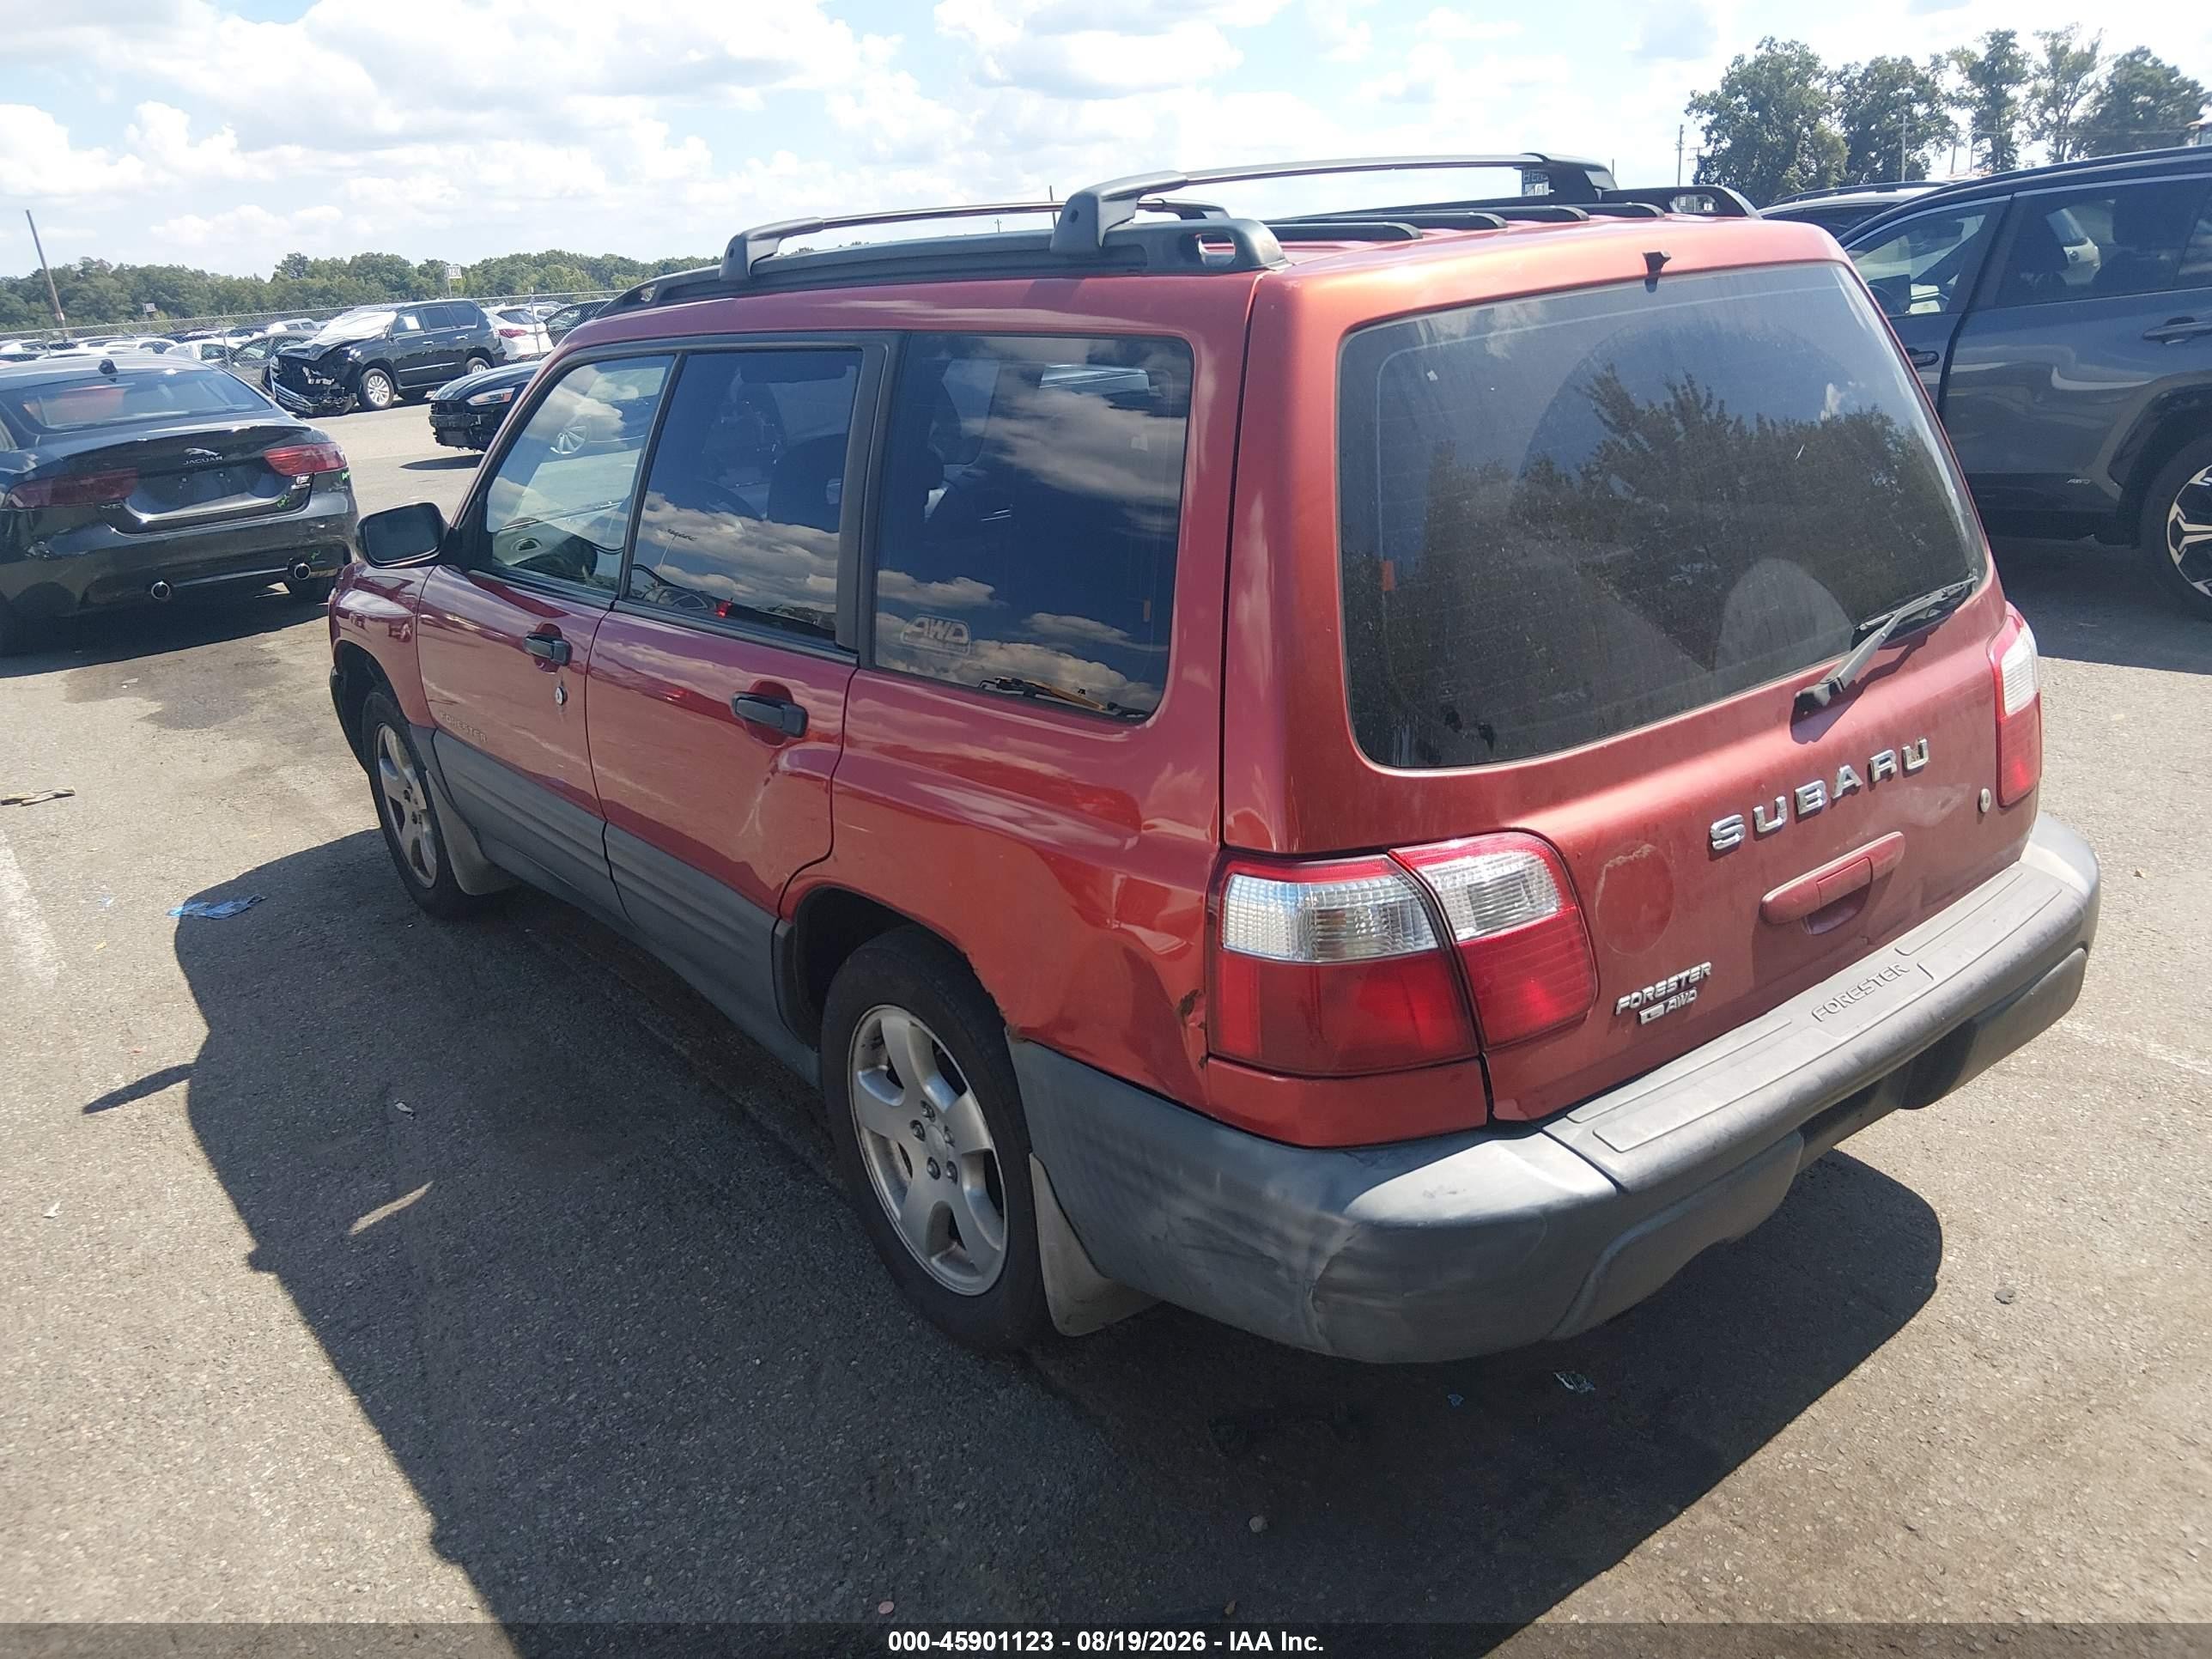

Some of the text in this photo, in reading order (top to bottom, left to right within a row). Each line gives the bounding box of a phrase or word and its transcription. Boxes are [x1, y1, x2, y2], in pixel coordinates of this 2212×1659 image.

[183, 456, 223, 465] JAGUAR
[903, 616, 969, 645] AWD
[1710, 738, 1929, 851] SUBARU
[1615, 961, 1711, 1016] FORESTER
[1666, 987, 1698, 1013] AWD
[1811, 963, 1911, 1023] FORESTER
